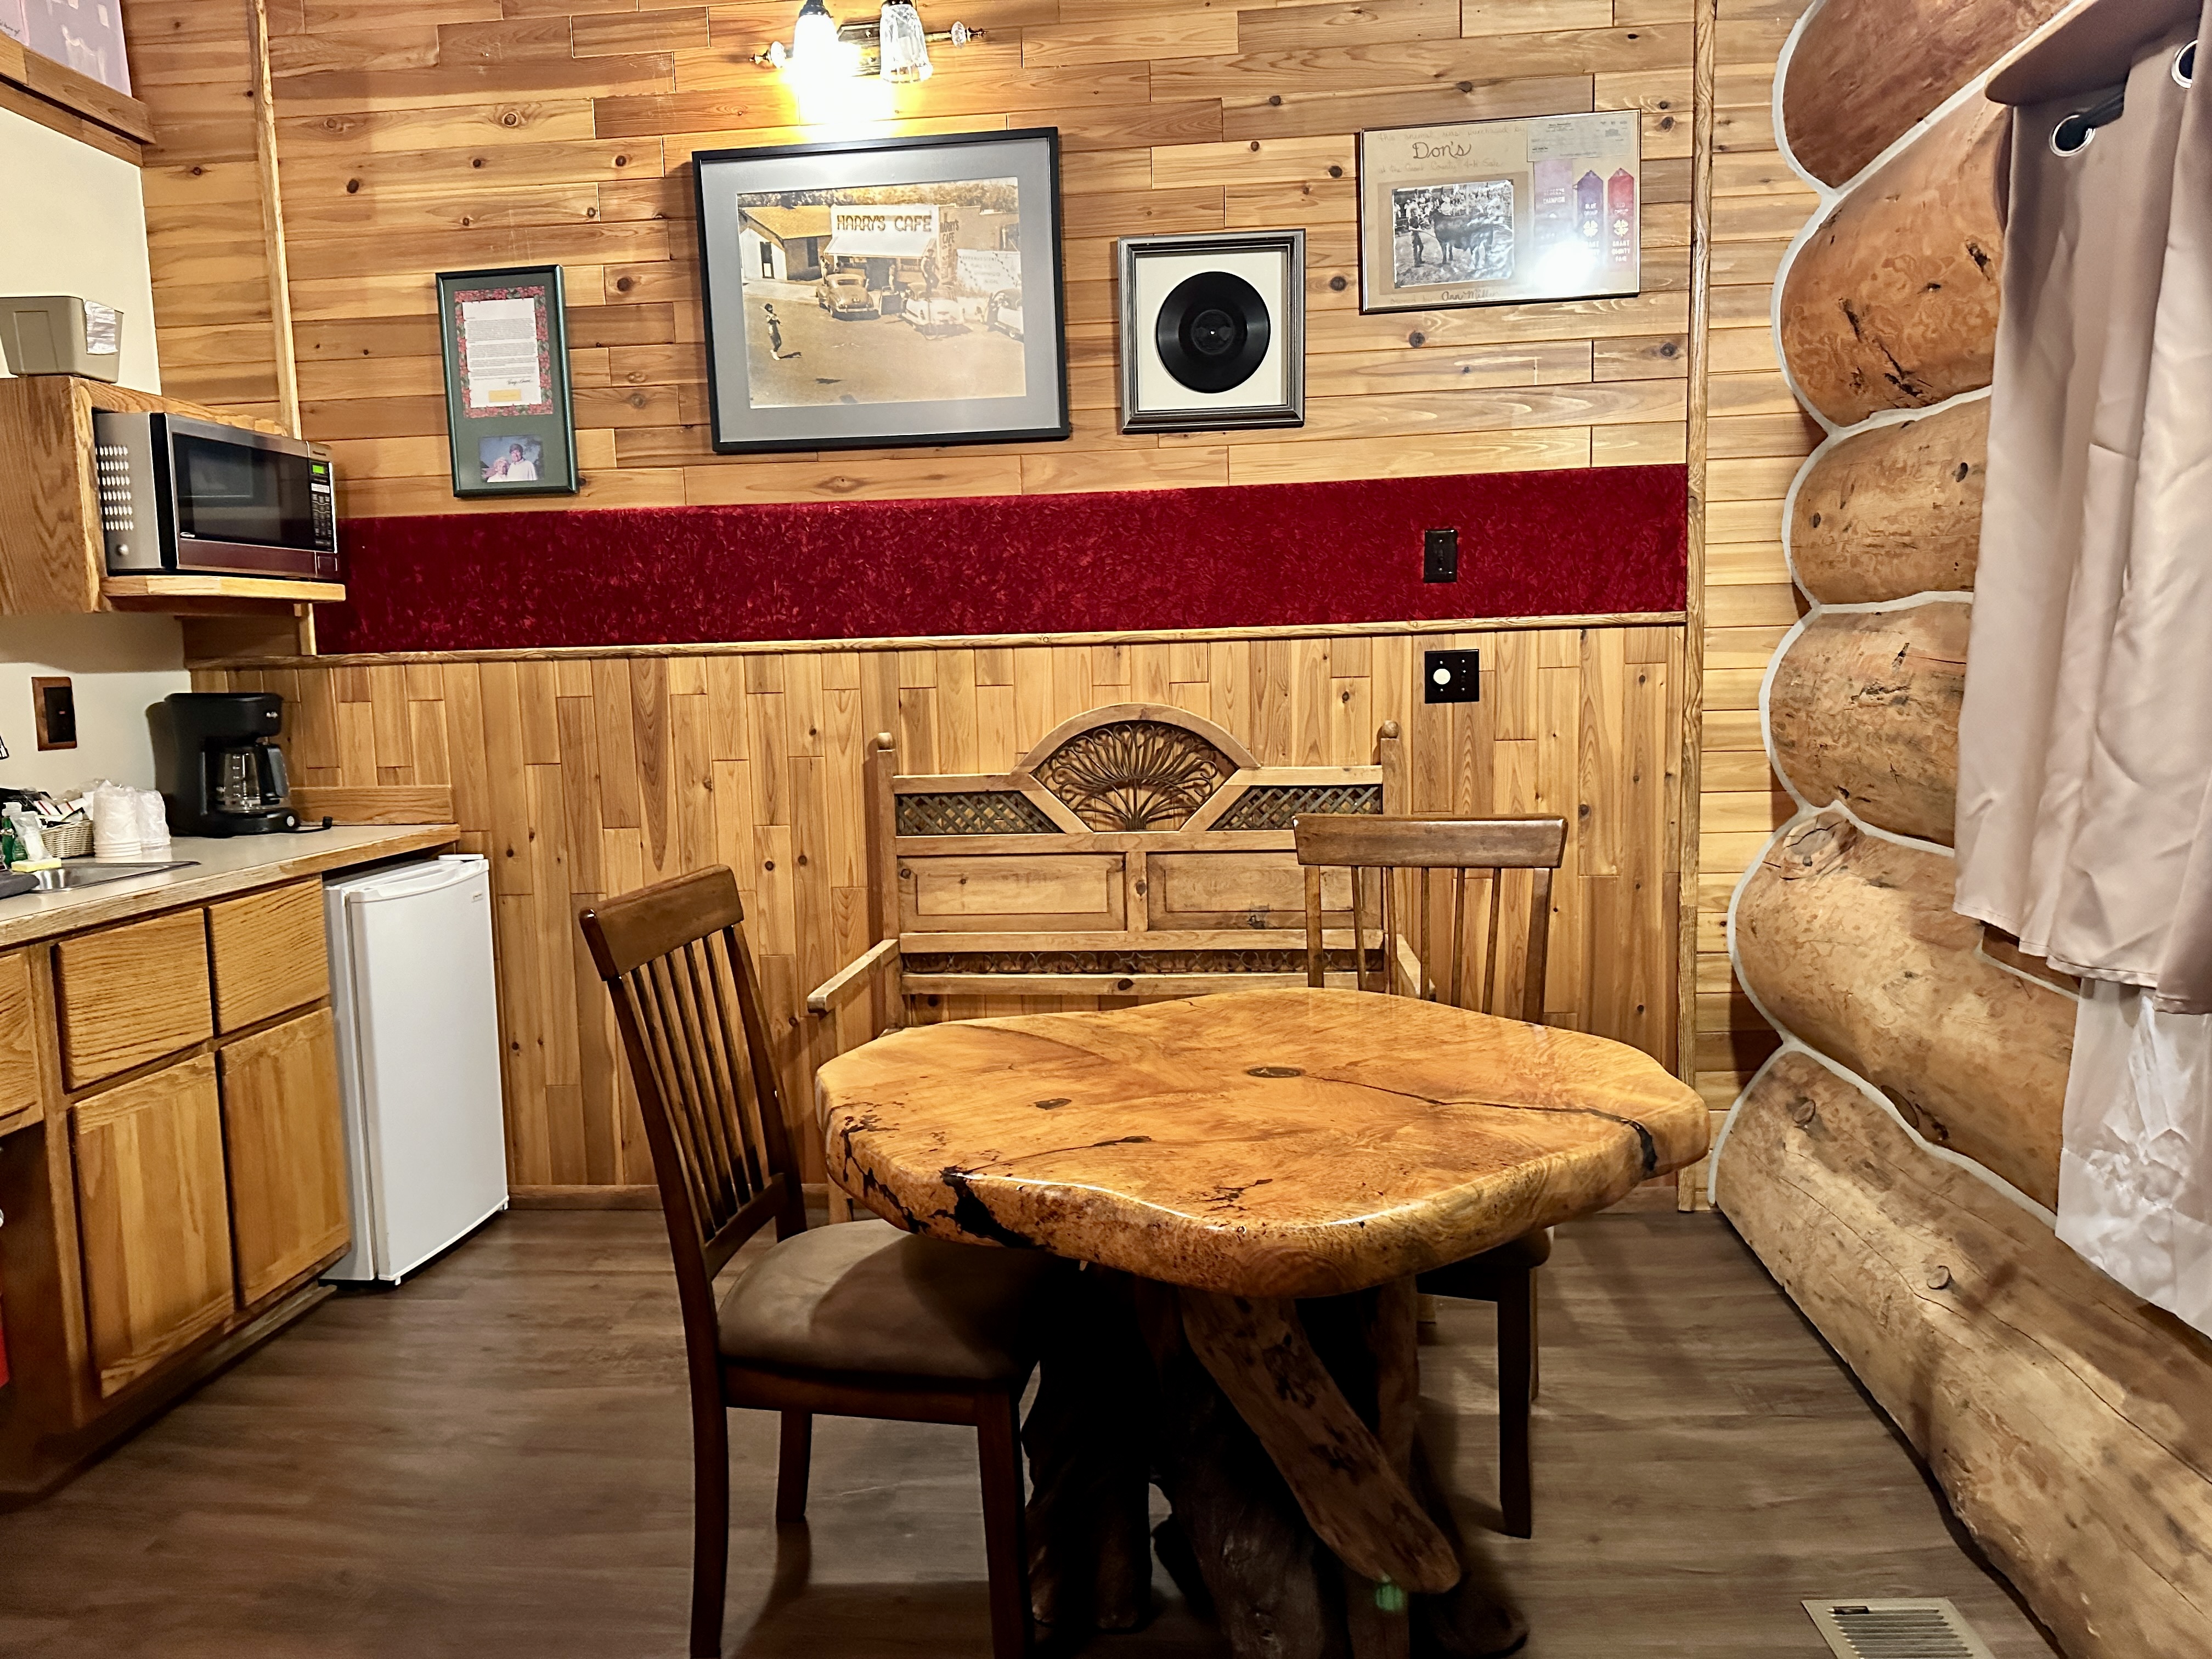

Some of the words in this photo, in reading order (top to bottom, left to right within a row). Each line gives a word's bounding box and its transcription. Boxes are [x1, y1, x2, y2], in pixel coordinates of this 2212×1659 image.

[1412, 141, 1472, 159] Don's
[1543, 196, 1565, 205] CHAMPION
[836, 215, 885, 232] HARRY'S
[894, 215, 932, 232] CAFE
[940, 219, 959, 233] HARRY'S
[942, 233, 955, 244] CAFE
